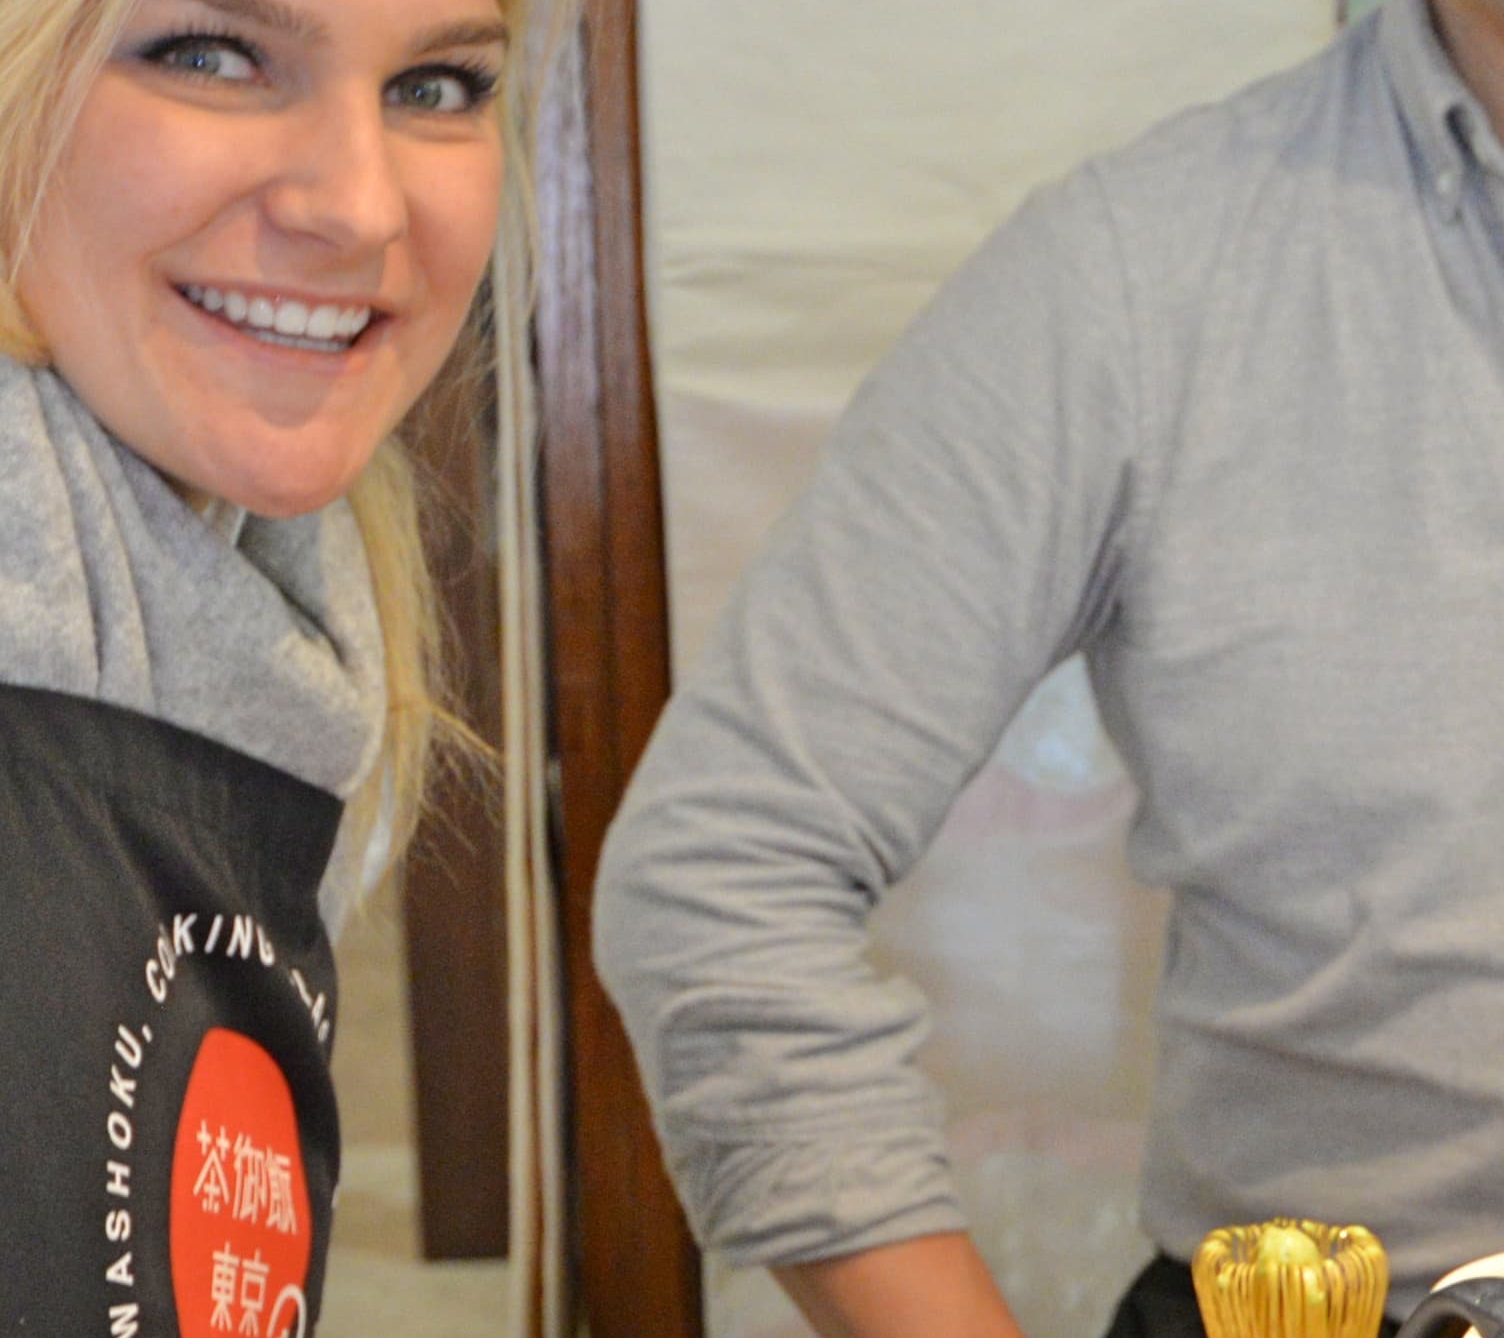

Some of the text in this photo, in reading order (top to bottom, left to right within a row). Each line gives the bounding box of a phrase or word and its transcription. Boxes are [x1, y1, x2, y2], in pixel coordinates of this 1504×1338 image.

[193, 1118, 298, 1236] 茶御飯
[210, 1241, 271, 1338] 東京
